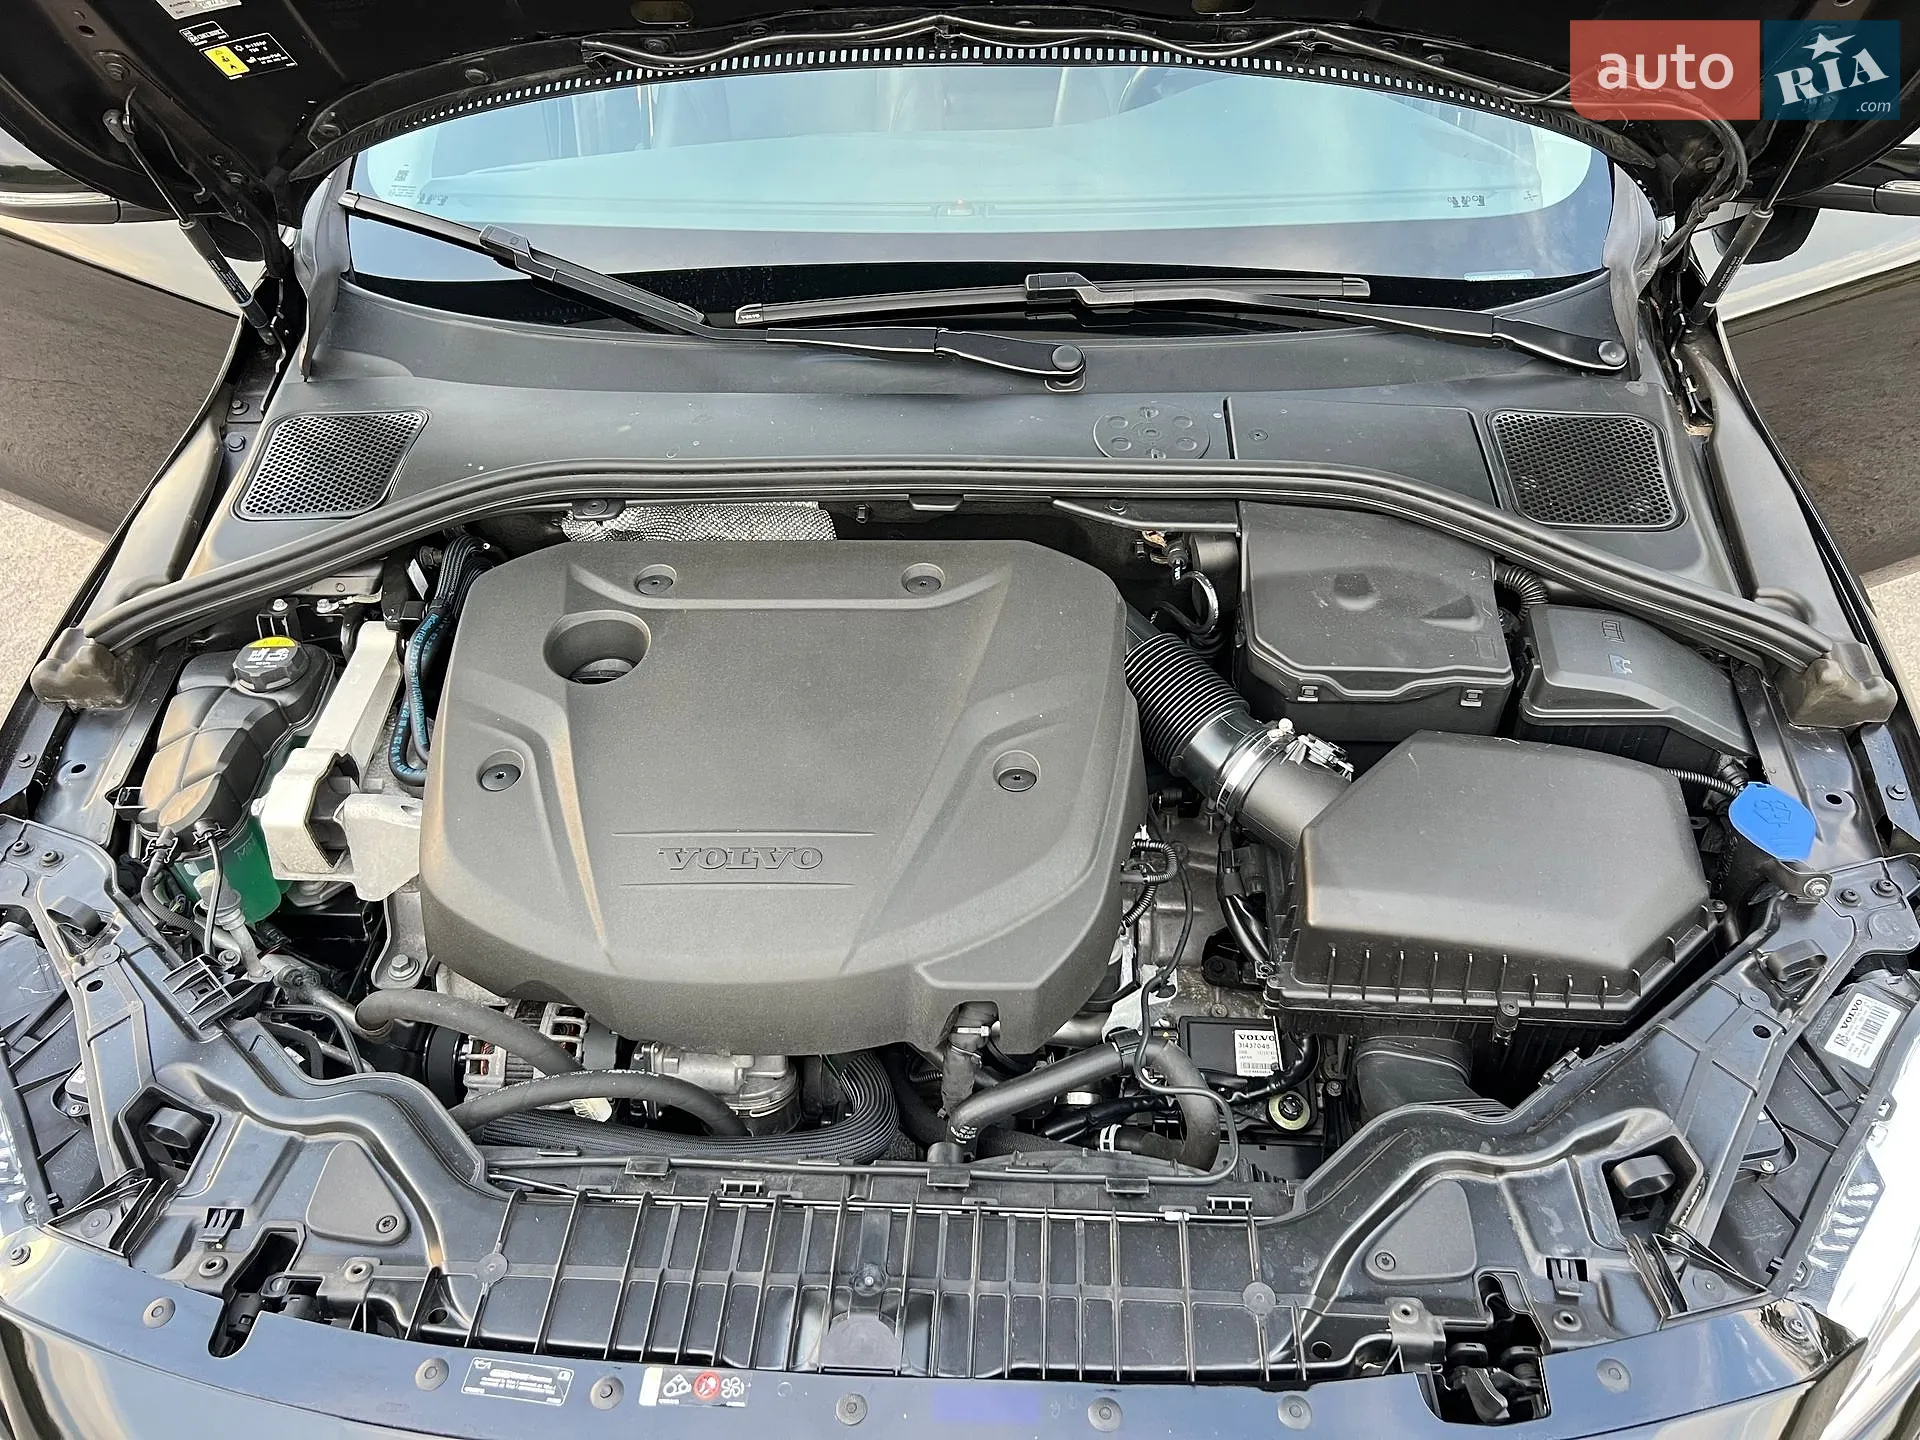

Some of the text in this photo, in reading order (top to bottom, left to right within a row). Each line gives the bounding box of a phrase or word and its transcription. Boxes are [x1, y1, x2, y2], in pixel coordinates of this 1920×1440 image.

[658, 847, 823, 870] VOLVO
[1840, 999, 1863, 1029] VOLVO
[1238, 1034, 1275, 1042] VOLVO
